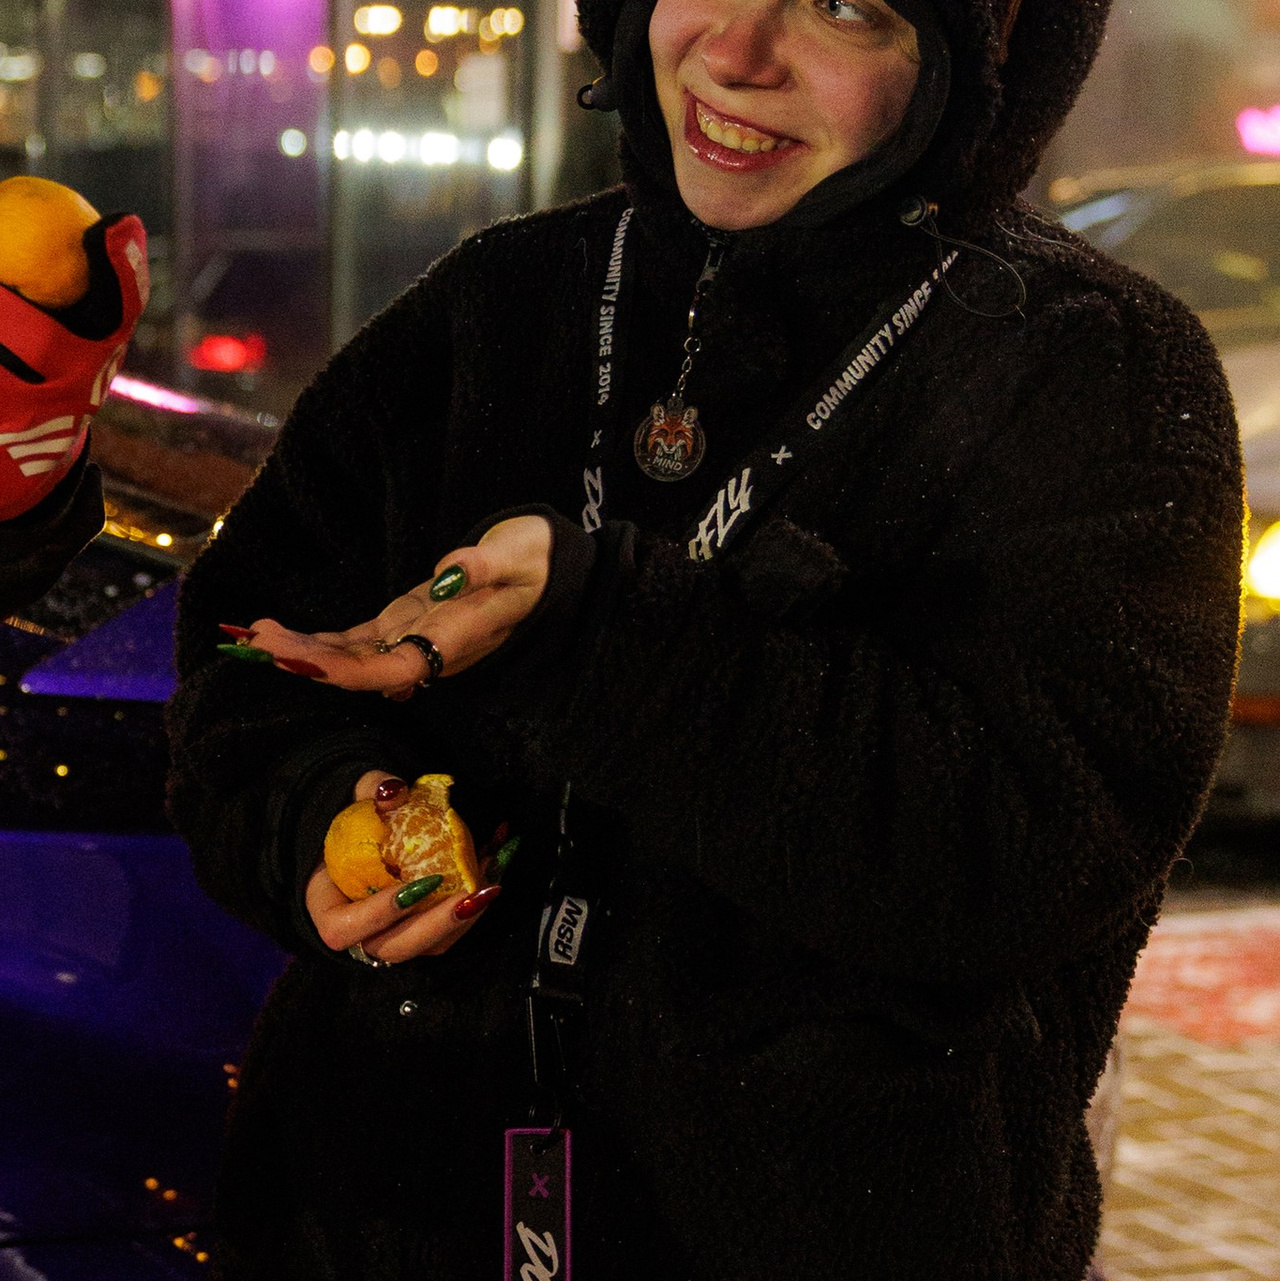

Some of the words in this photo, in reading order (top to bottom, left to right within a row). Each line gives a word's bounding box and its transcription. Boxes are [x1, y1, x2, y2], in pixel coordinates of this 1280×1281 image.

[601, 207, 634, 302] COMMUNITY
[599, 305, 616, 357] SINCE
[806, 322, 896, 431] COMMUNITY
[891, 280, 933, 336] SINCE
[652, 456, 683, 472] MIND
[554, 898, 584, 962] RSW
